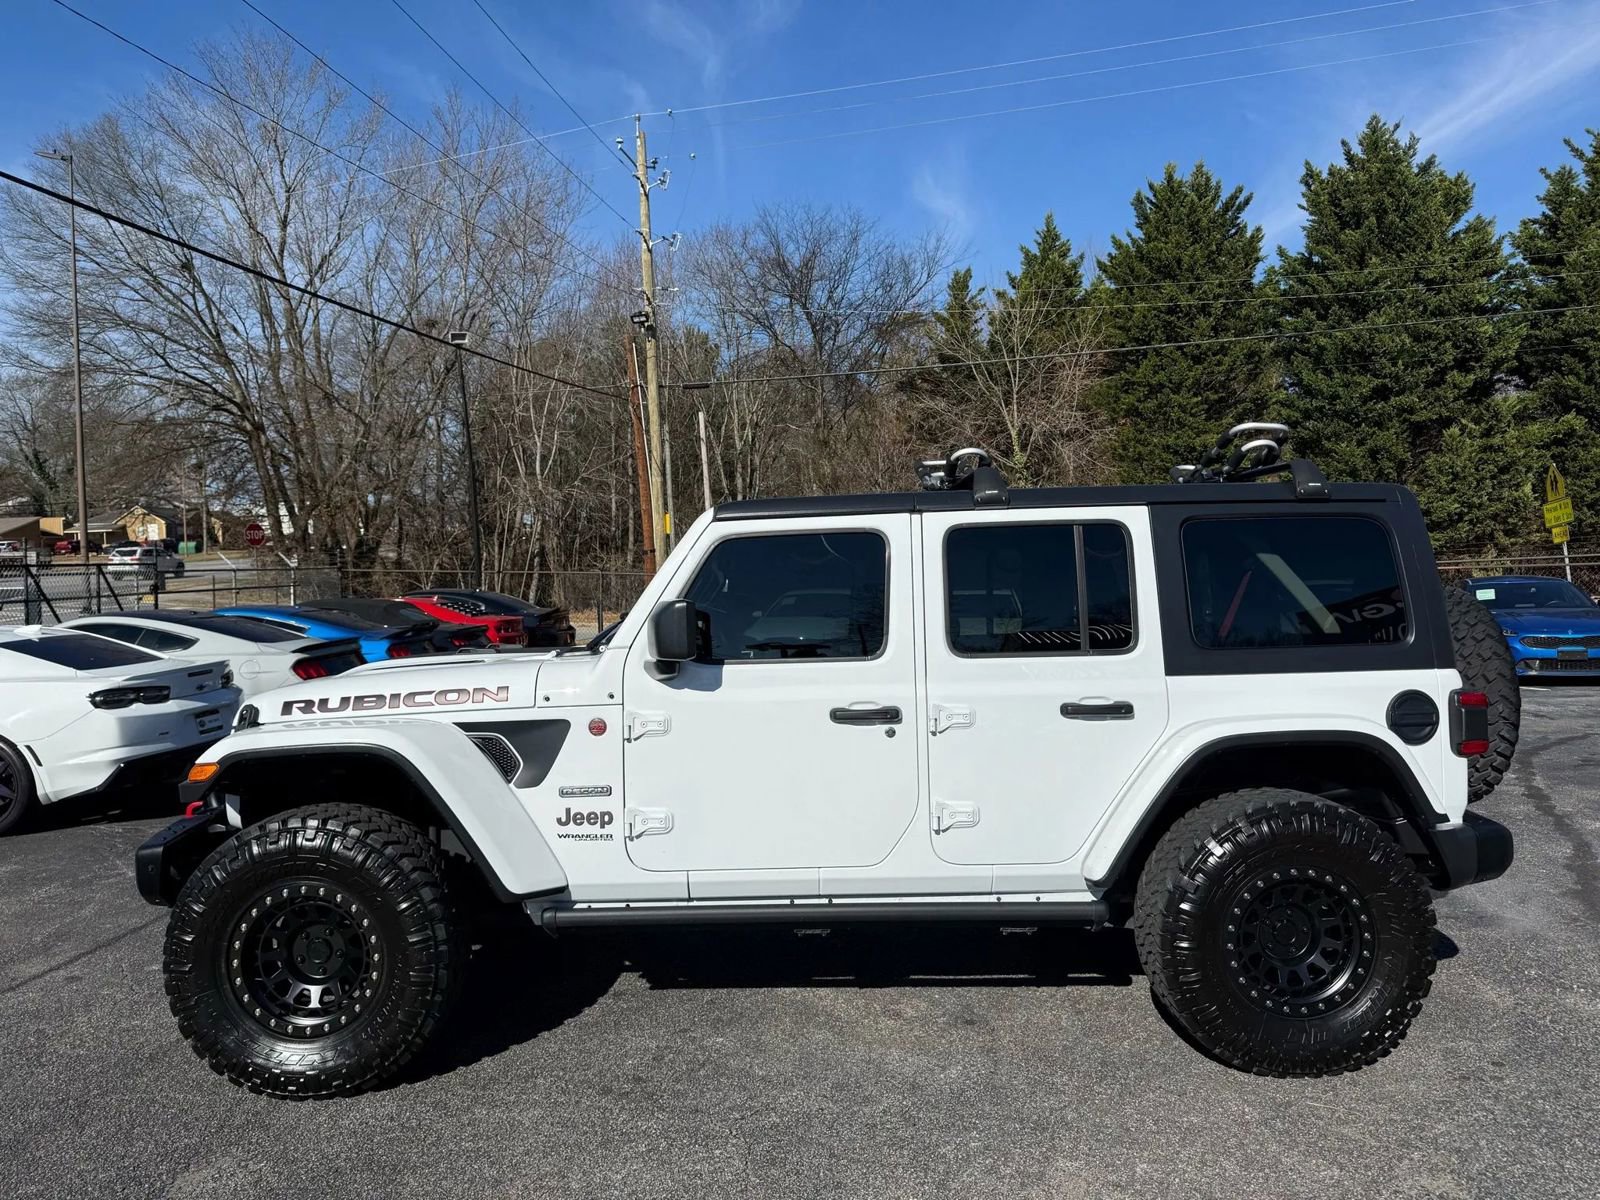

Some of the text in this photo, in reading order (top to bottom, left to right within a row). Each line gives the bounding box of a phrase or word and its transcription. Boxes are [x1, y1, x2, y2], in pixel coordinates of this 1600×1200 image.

[246, 530, 264, 540] STOP
[280, 685, 510, 717] RUBICON
[556, 807, 614, 829] Jeep
